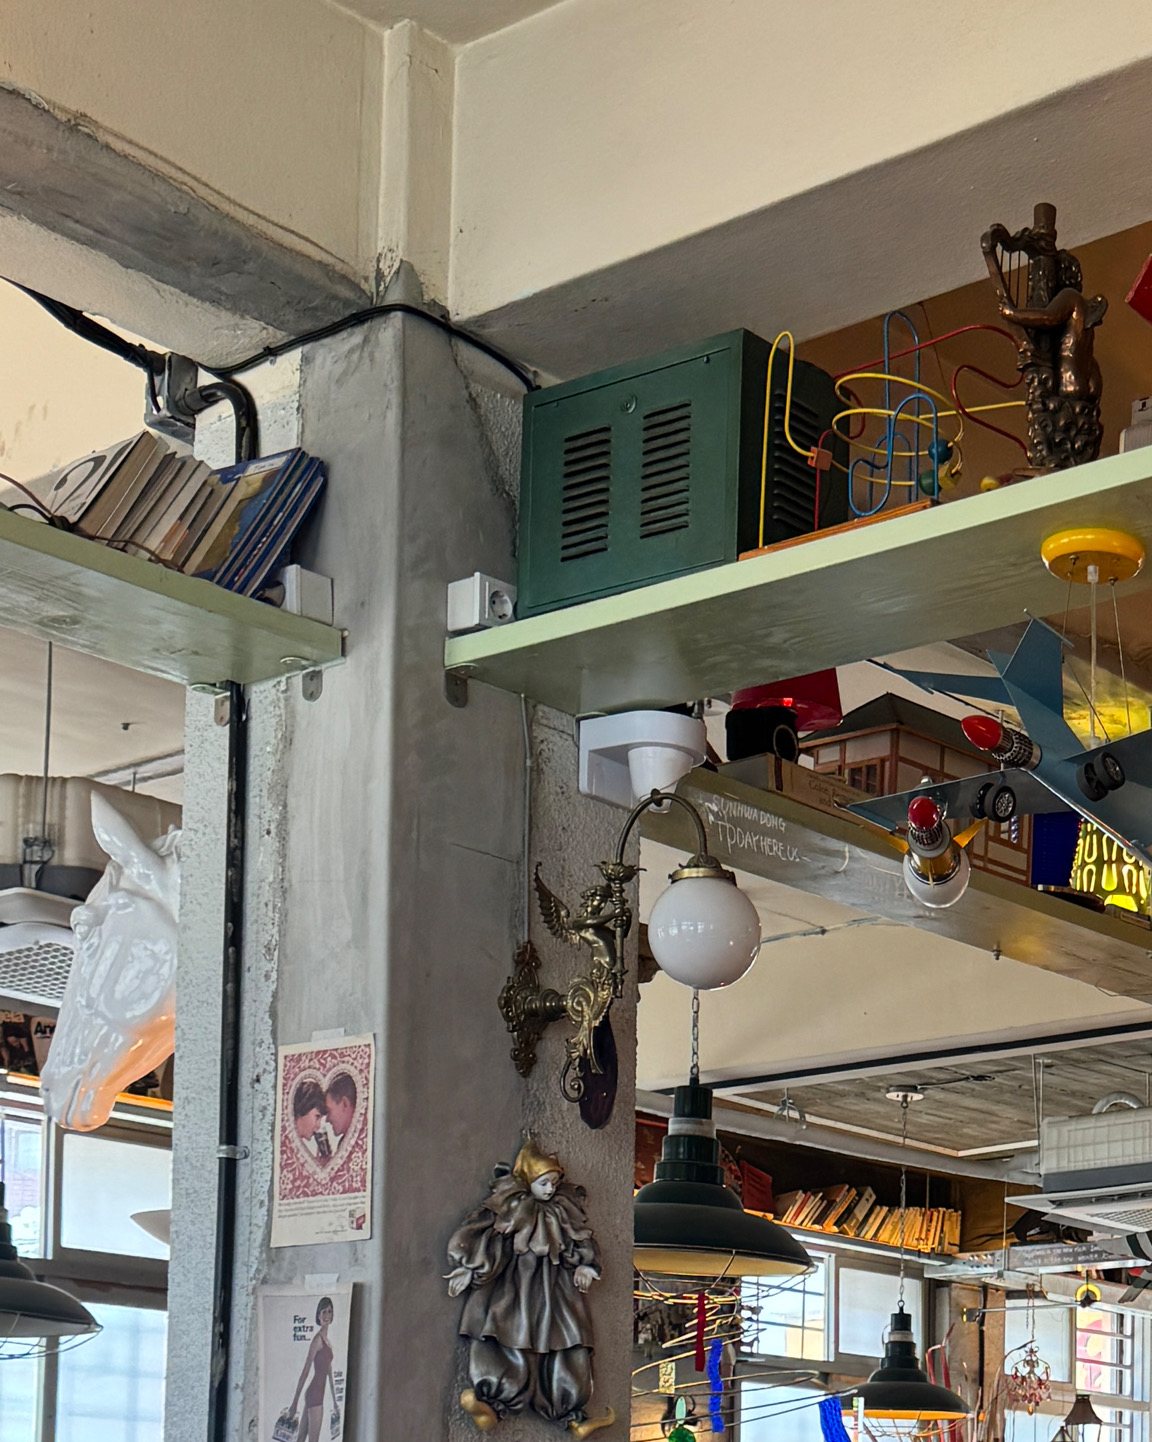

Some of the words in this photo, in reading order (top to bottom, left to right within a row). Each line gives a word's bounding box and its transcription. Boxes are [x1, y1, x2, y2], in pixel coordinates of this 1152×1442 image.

[759, 810, 786, 833] DONG
[712, 820, 758, 853] TODAY
[293, 1315, 307, 1324] For
[293, 1325, 314, 1333] extra
